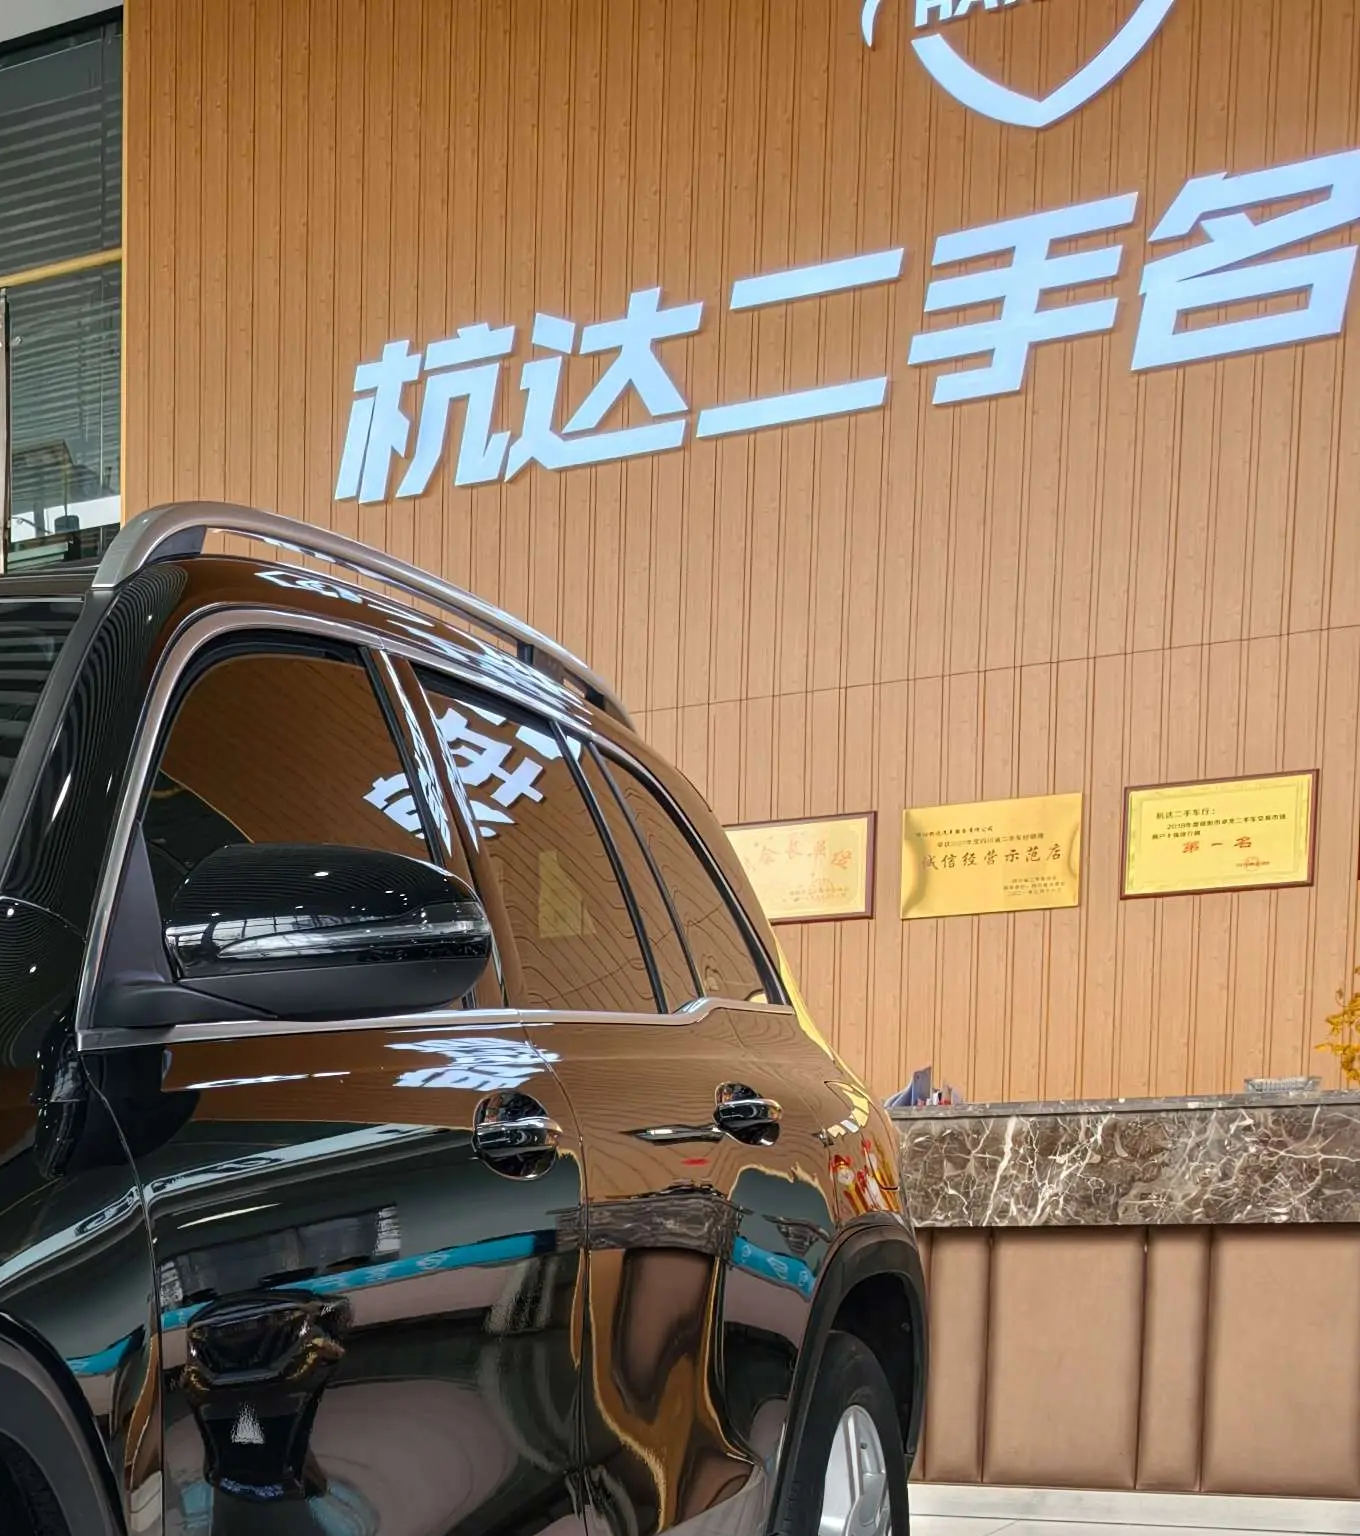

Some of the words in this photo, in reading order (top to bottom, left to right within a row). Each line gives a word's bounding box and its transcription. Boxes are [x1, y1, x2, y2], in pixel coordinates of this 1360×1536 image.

[335, 149, 1360, 505] 杭达二手名
[922, 843, 1062, 870] 诚信经营示范店
